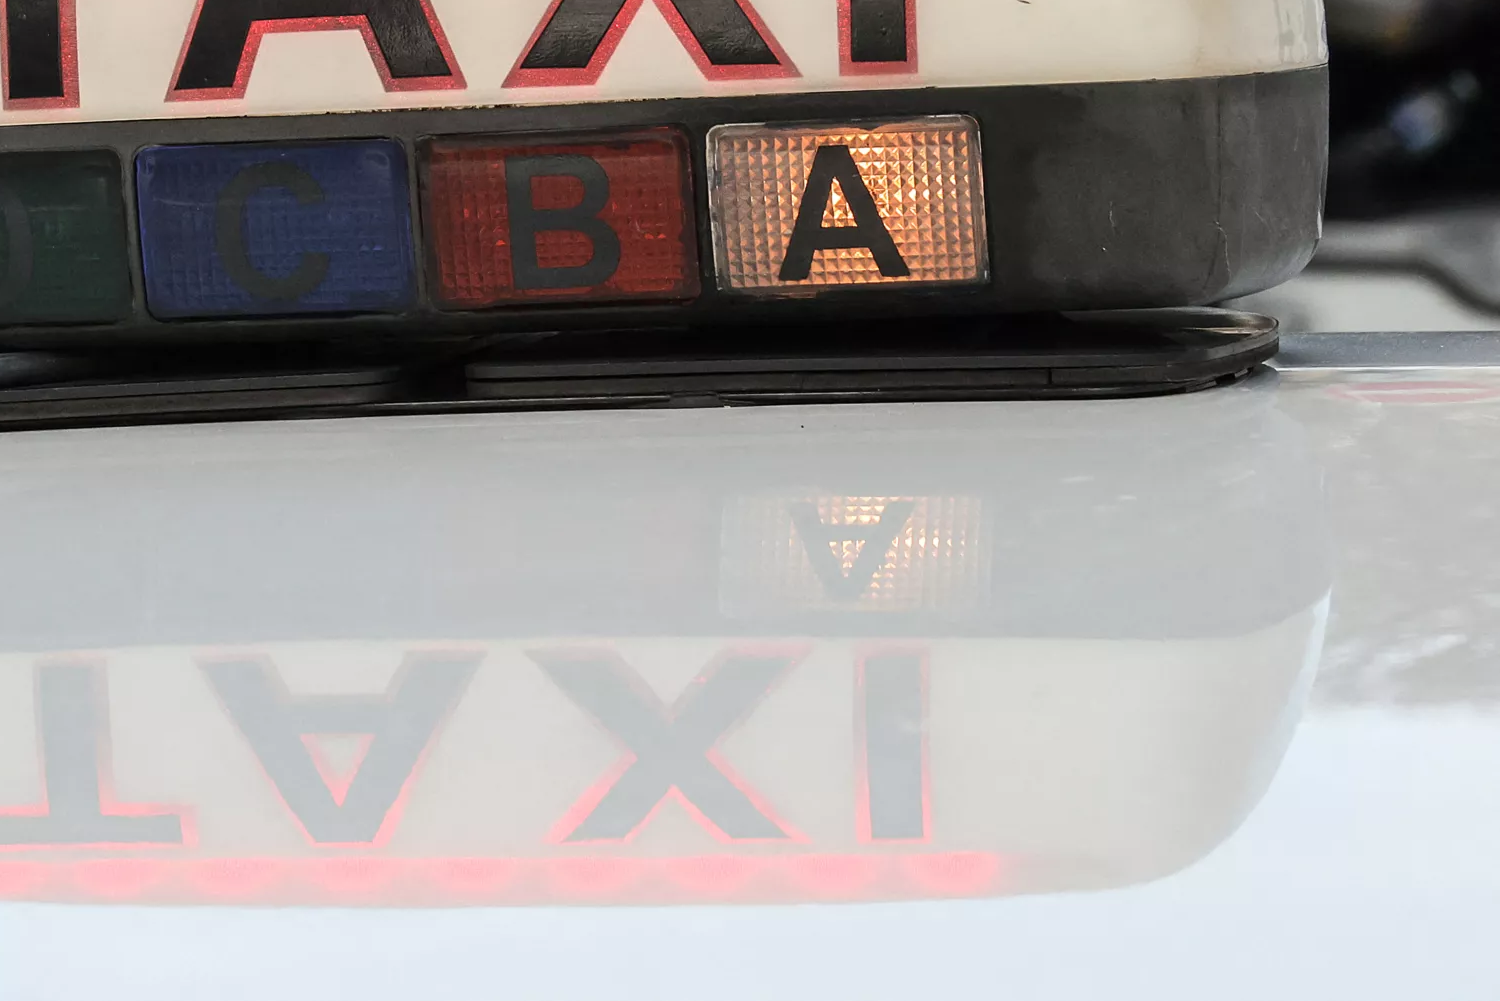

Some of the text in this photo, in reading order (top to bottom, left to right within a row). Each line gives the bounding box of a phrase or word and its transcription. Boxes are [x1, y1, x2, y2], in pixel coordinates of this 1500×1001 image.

[214, 158, 330, 300] C
[503, 152, 622, 290] B
[777, 143, 913, 284] A
